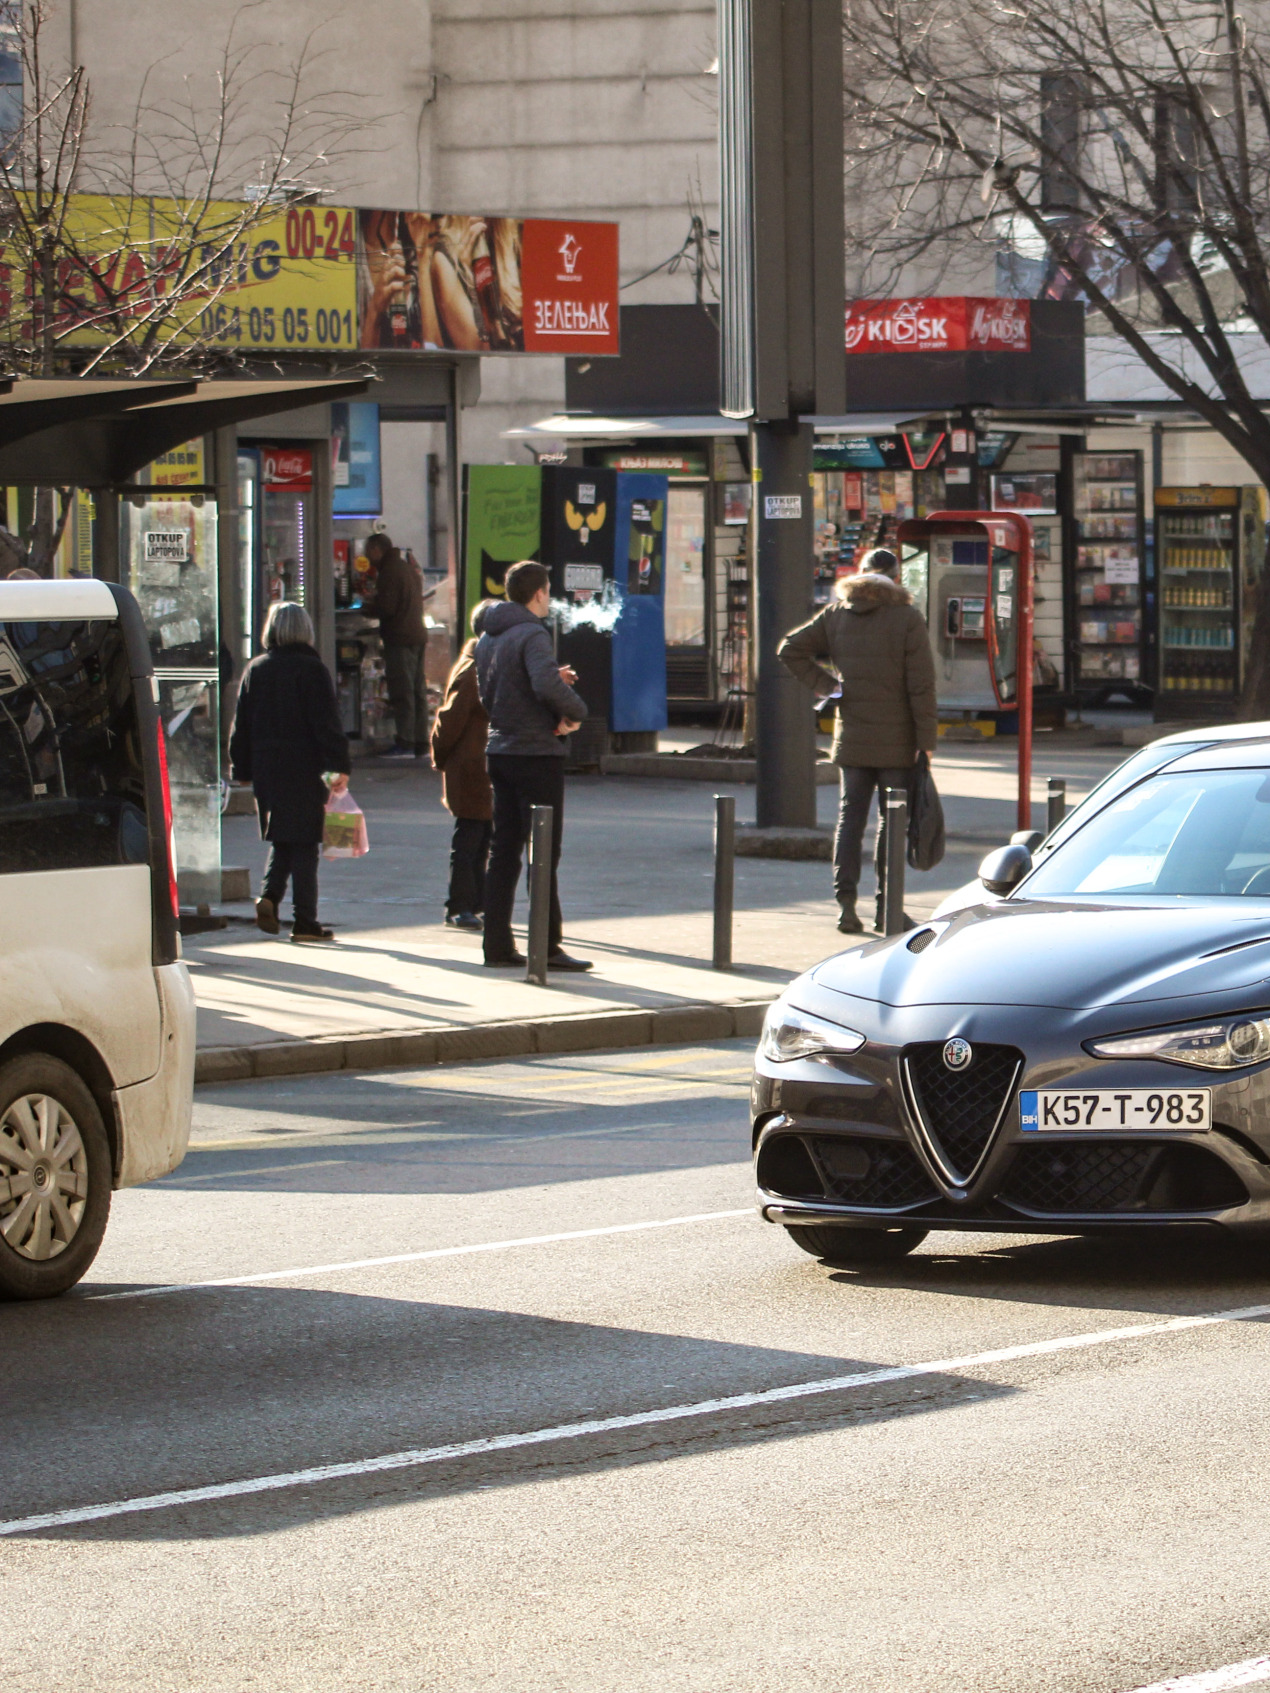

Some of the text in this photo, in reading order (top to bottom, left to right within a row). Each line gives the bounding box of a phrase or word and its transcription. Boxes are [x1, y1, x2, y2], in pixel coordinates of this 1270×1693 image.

[286, 208, 355, 262] 00-24
[201, 239, 281, 287] MIG
[201, 304, 242, 342] 064
[250, 306, 276, 343] 05
[283, 307, 310, 343] 05
[316, 308, 353, 344] 001
[534, 300, 610, 330] ЗЕЛЕЊАК
[845, 309, 866, 348] oj
[147, 547, 185, 557] LAPTOPOVA
[148, 533, 184, 543] OTKUP
[1022, 1115, 1038, 1124] BIH
[1043, 1094, 1204, 1126] K57-T-983
